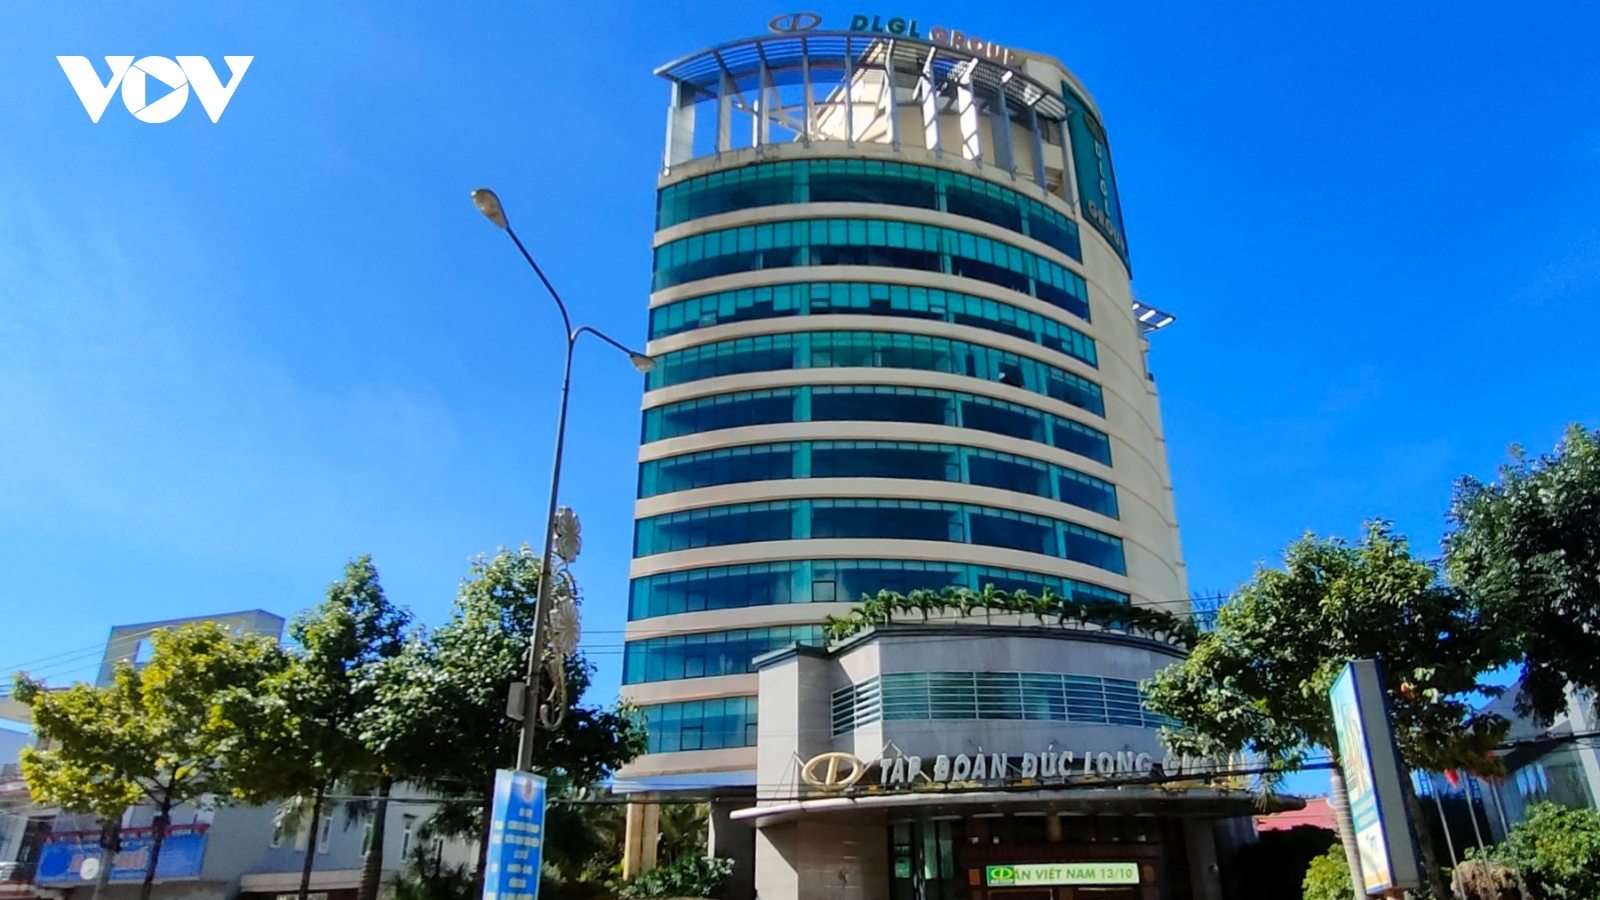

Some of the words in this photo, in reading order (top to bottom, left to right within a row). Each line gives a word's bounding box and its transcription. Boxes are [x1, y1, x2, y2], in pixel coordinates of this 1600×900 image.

[850, 14, 920, 38] DLGL
[928, 26, 1016, 66] GROUP
[933, 746, 1007, 782] ĐOÀN
[1021, 744, 1073, 778] ĐỨC
[1084, 750, 1152, 778] LONG
[1066, 868, 1096, 879] NAM
[1100, 868, 1133, 879] 13/10
